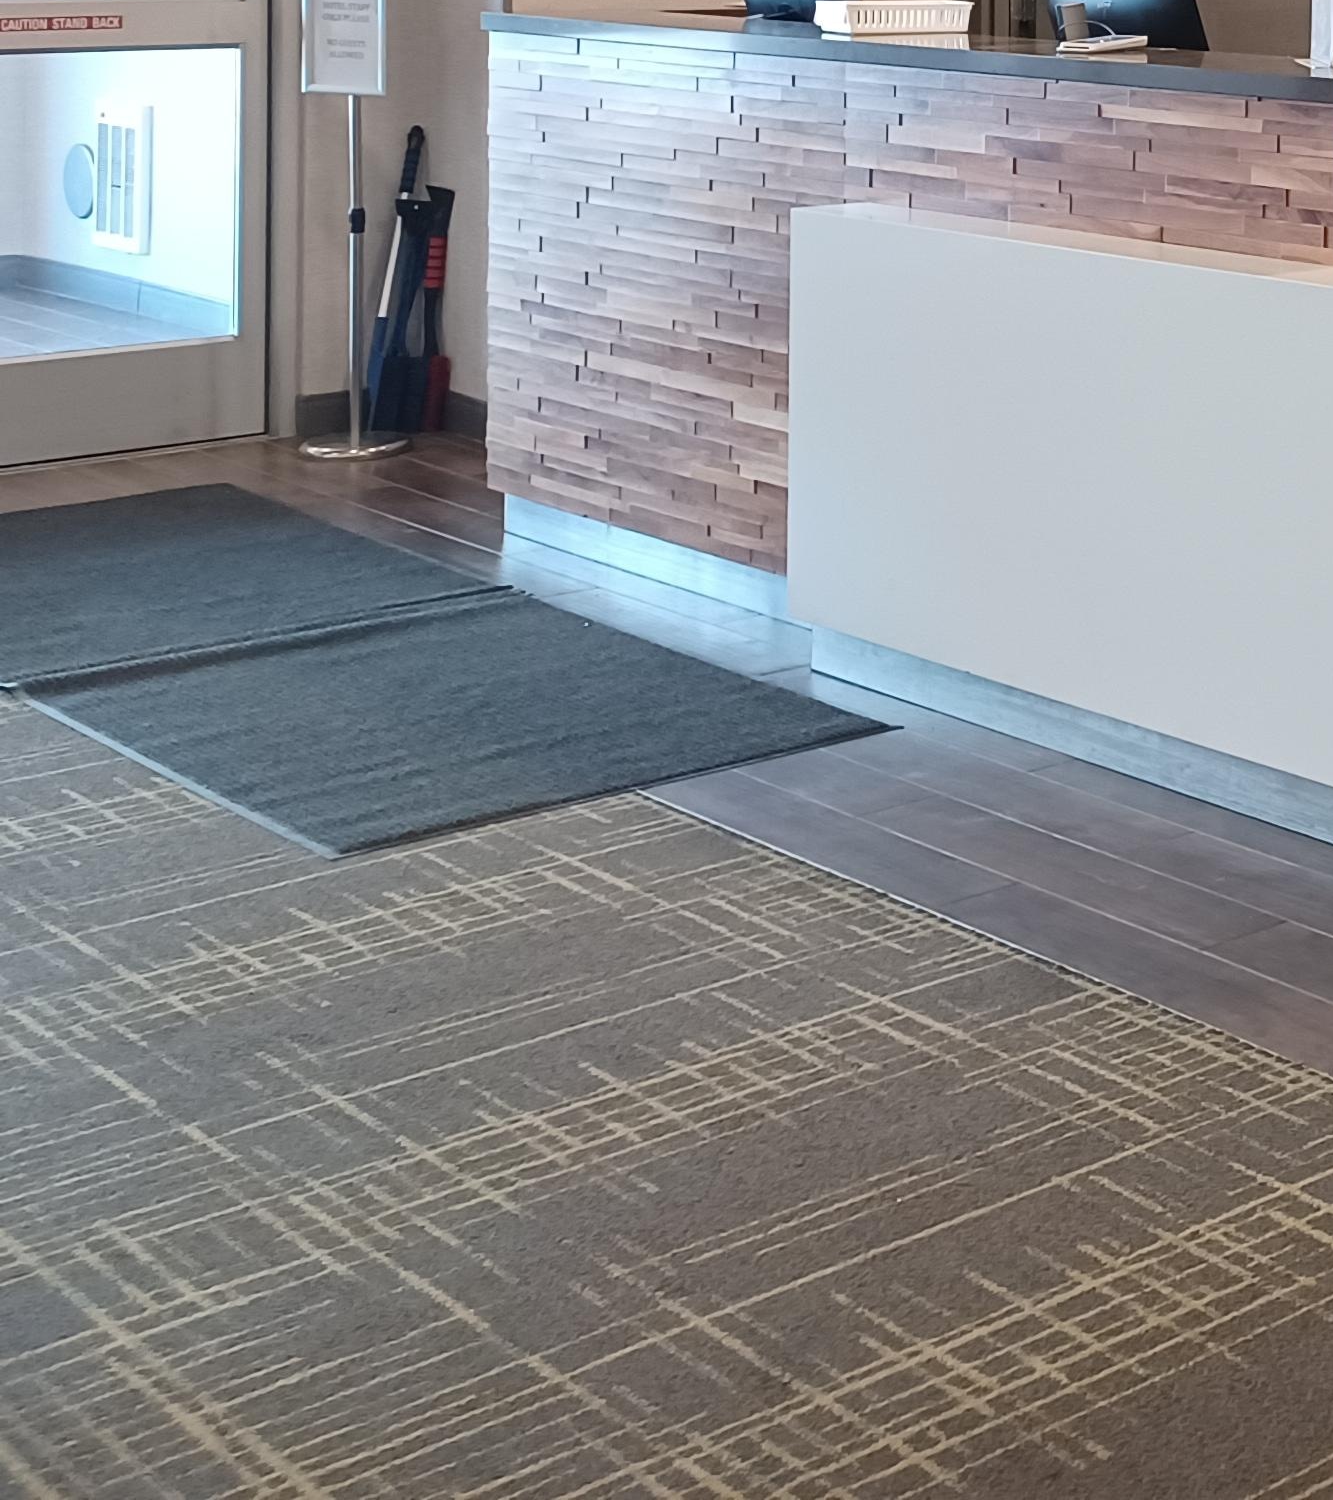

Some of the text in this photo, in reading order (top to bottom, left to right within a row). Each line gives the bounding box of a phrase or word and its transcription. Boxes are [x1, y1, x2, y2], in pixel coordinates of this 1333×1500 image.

[1, 16, 120, 31] CAUTION STAND BACK
